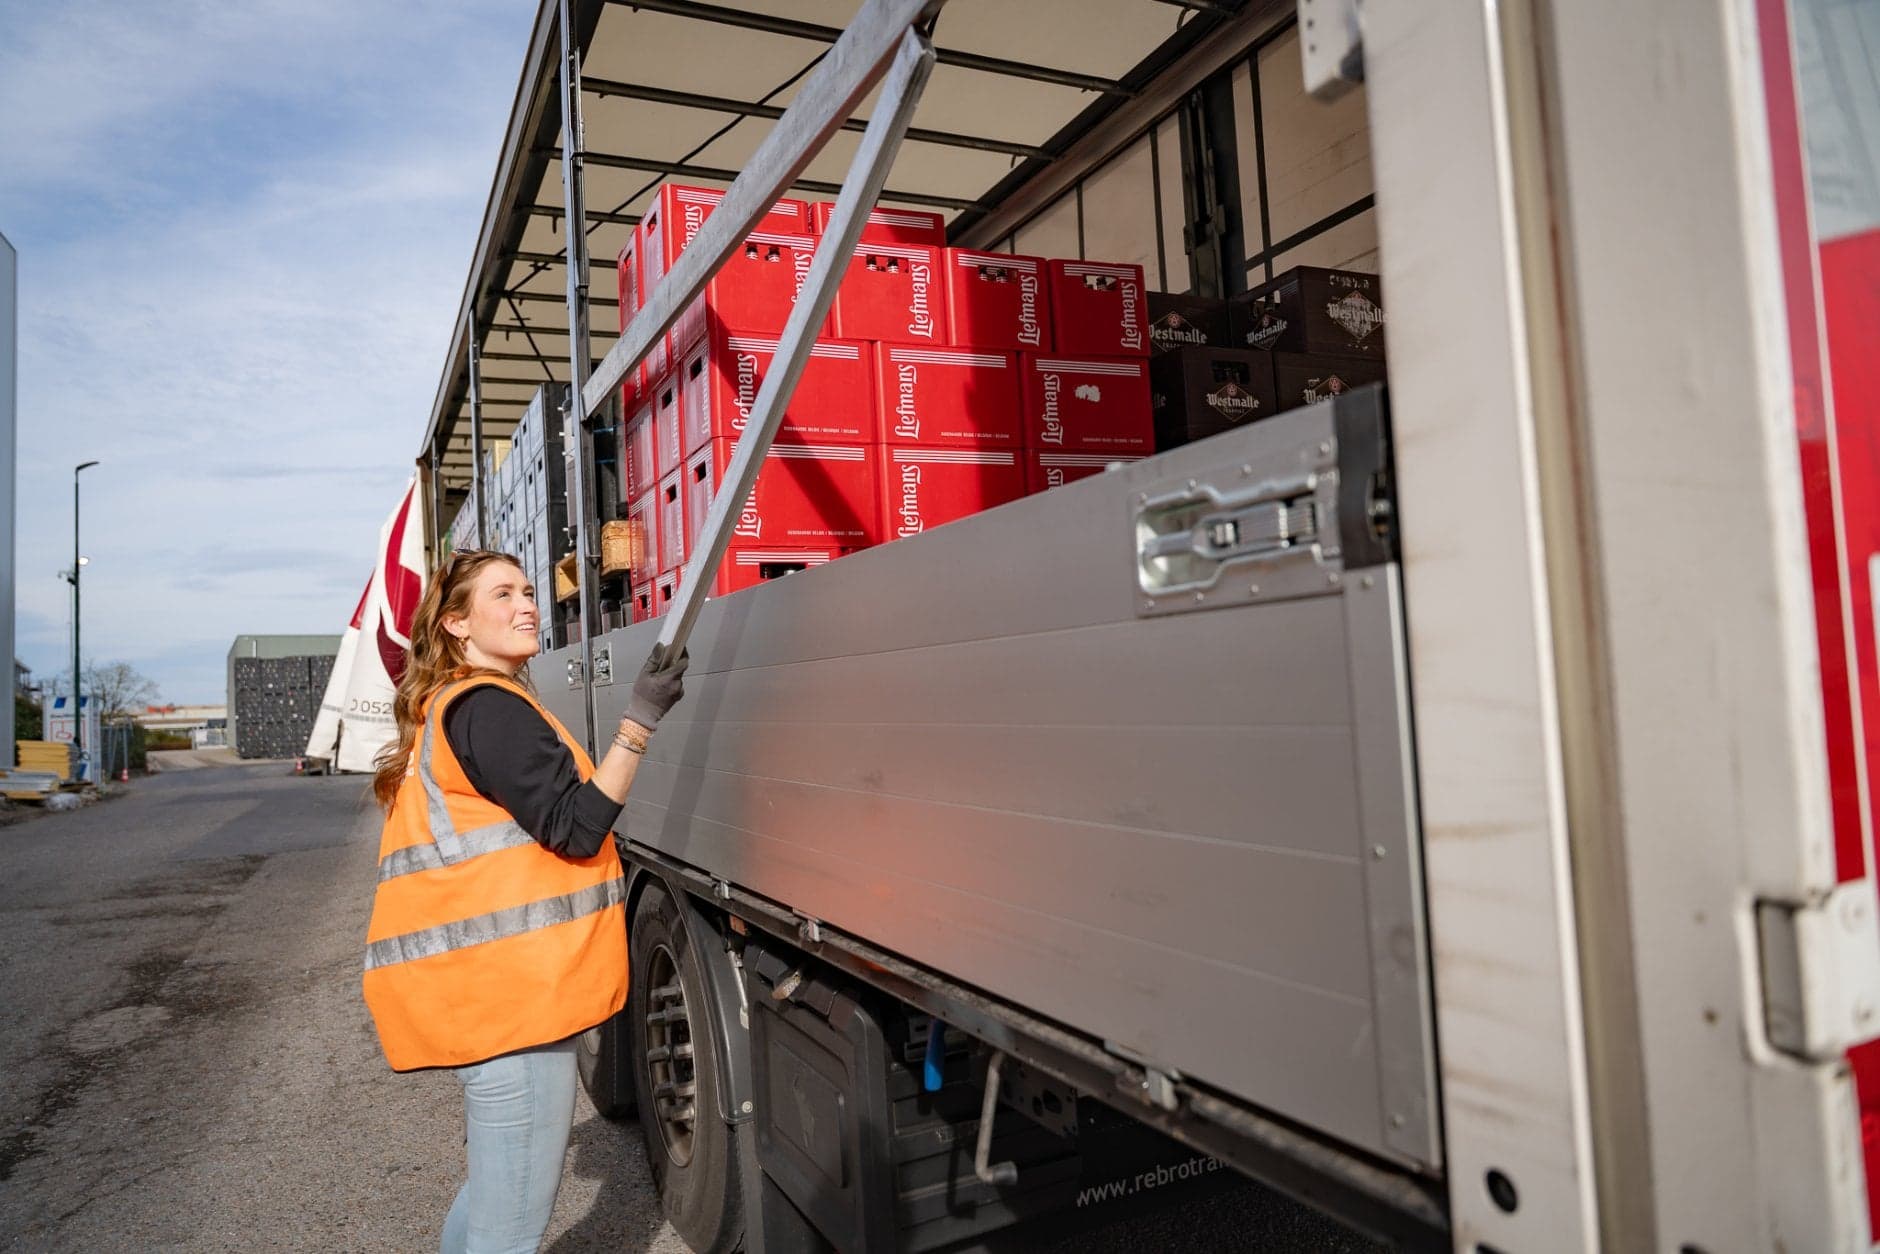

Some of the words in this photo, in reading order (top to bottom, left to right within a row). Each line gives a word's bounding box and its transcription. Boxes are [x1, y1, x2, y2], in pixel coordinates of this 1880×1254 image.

[681, 204, 704, 250] mans
[791, 252, 814, 304] mans
[908, 264, 934, 339] Liefmans
[1017, 275, 1041, 347] Liefmans
[1120, 282, 1142, 350] Liefmans
[1246, 319, 1289, 345] Westmalle
[894, 364, 920, 440] Liefmans
[1041, 373, 1064, 445] Liefmans
[1206, 393, 1260, 409] Westmalle
[897, 465, 924, 538] Liefmans
